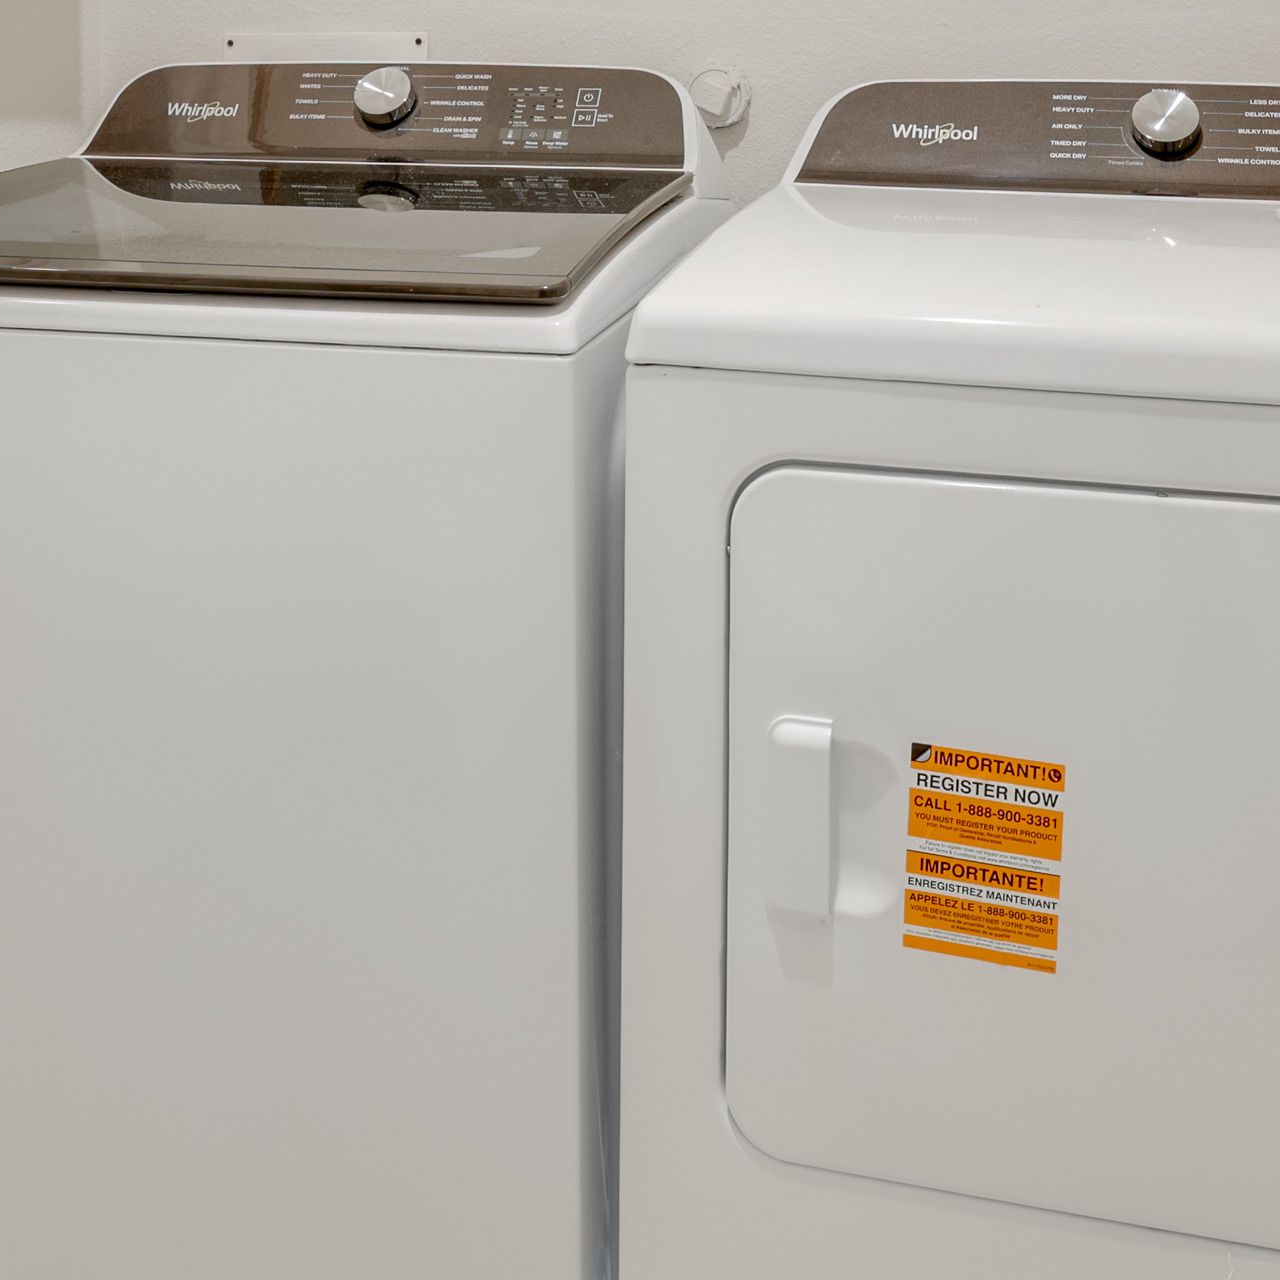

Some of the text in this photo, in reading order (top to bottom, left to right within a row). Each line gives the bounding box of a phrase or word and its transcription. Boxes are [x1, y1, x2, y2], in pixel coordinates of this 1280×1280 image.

[167, 102, 239, 122] Whirlpool
[892, 123, 978, 145] Whirlpool
[934, 750, 1046, 781] IMPORTANT!
[916, 773, 1058, 807] REGISTER NOW
[914, 795, 1057, 828] CALL 1-888-900-3381
[915, 812, 1058, 841] YOU MUST REGISTER YOUR PRODUCT
[920, 858, 1044, 892] IMPORTANTE!
[908, 876, 1058, 910] ENREGISTREZ MAINTENANT
[910, 893, 1053, 926] APPELEZ LE 1-888-900-3381
[911, 904, 1054, 934] VOUS DEVEZ ENREGISTRER VOTRE PRODUIT
